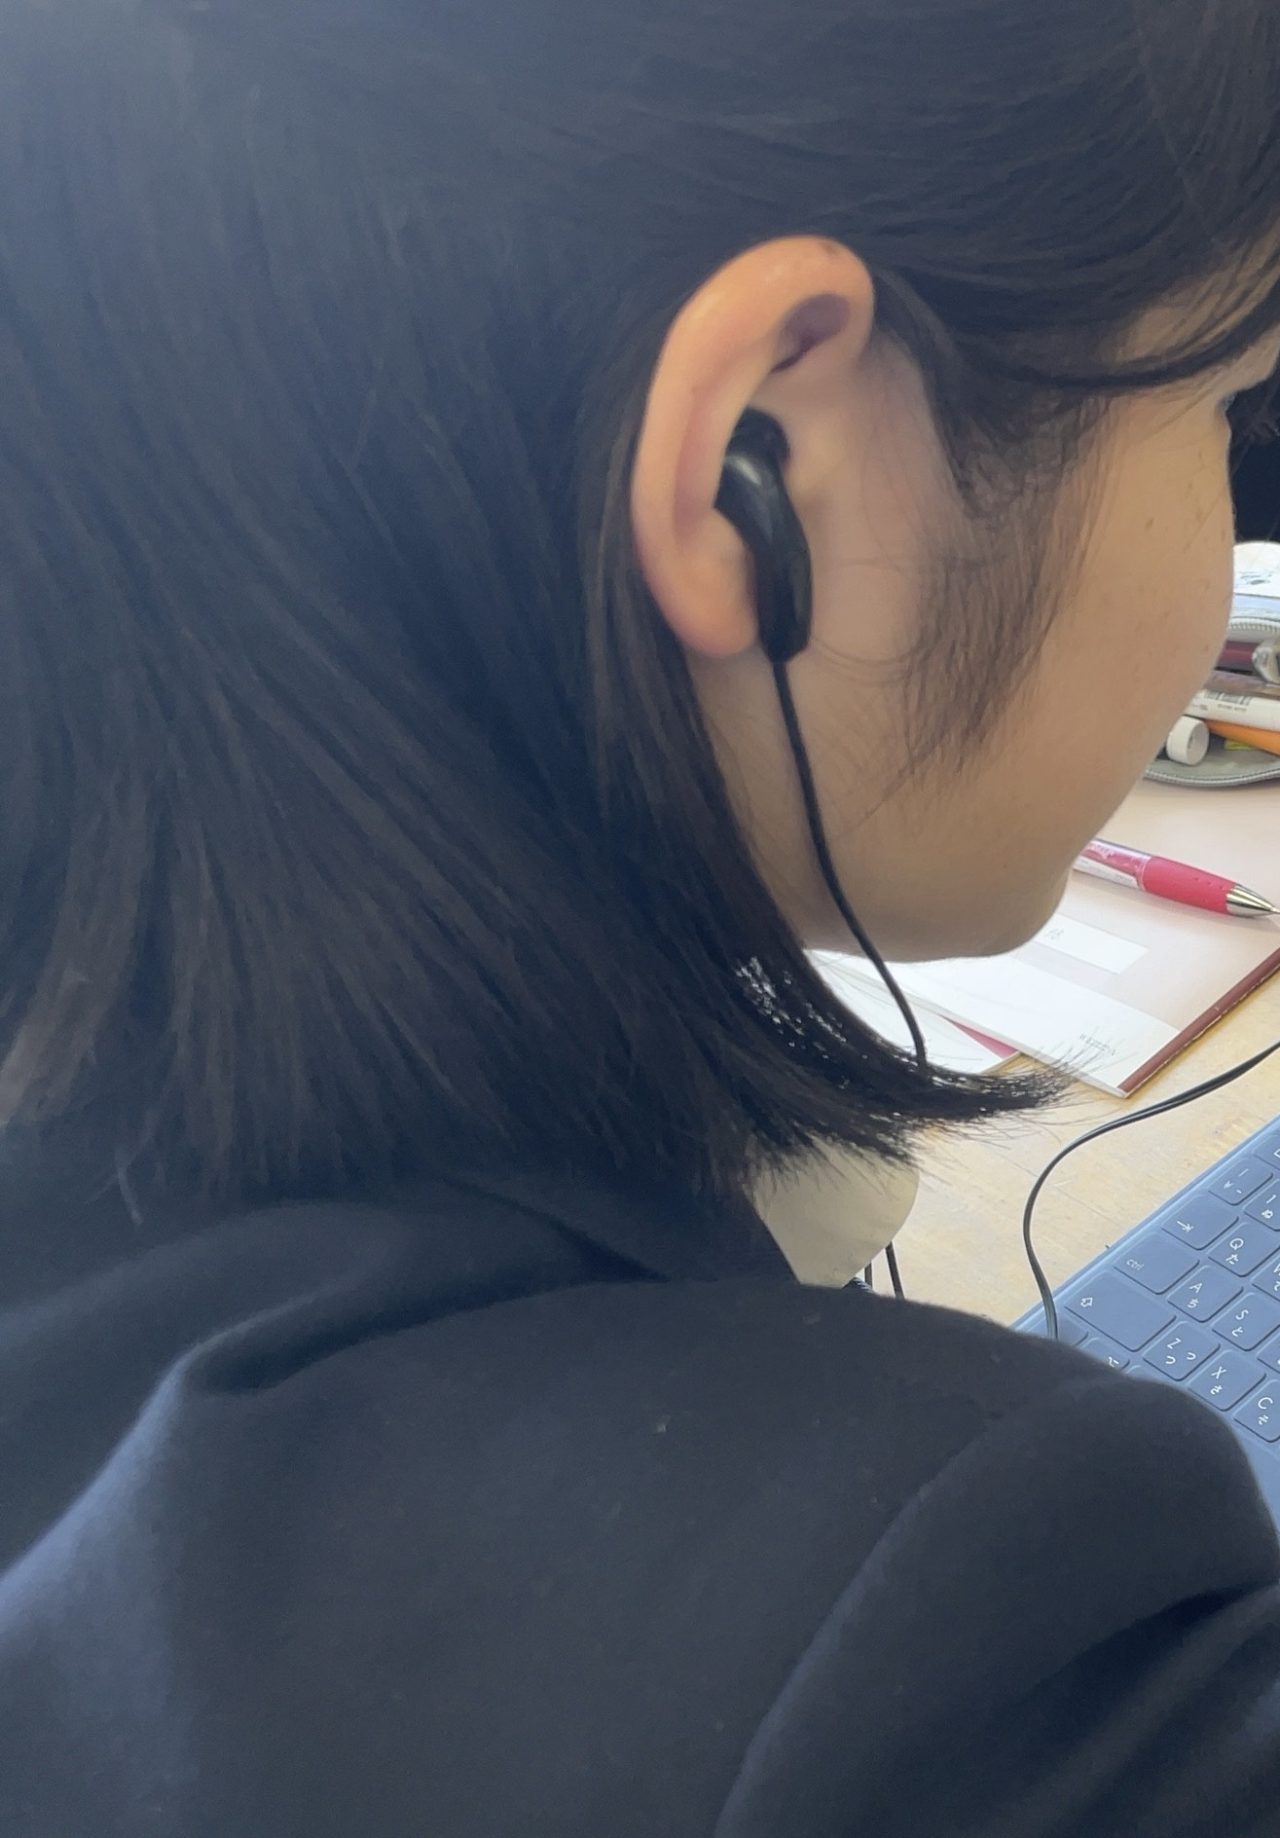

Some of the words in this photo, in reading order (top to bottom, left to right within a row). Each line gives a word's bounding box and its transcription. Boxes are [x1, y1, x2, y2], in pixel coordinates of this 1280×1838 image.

[1229, 1237, 1244, 1251] Q
[1126, 1258, 1145, 1271] ctrl
[1188, 1282, 1203, 1294] A
[1235, 1309, 1249, 1321] S
[1166, 1337, 1182, 1350] Z
[1211, 1366, 1227, 1380] X
[1257, 1396, 1274, 1410] C
